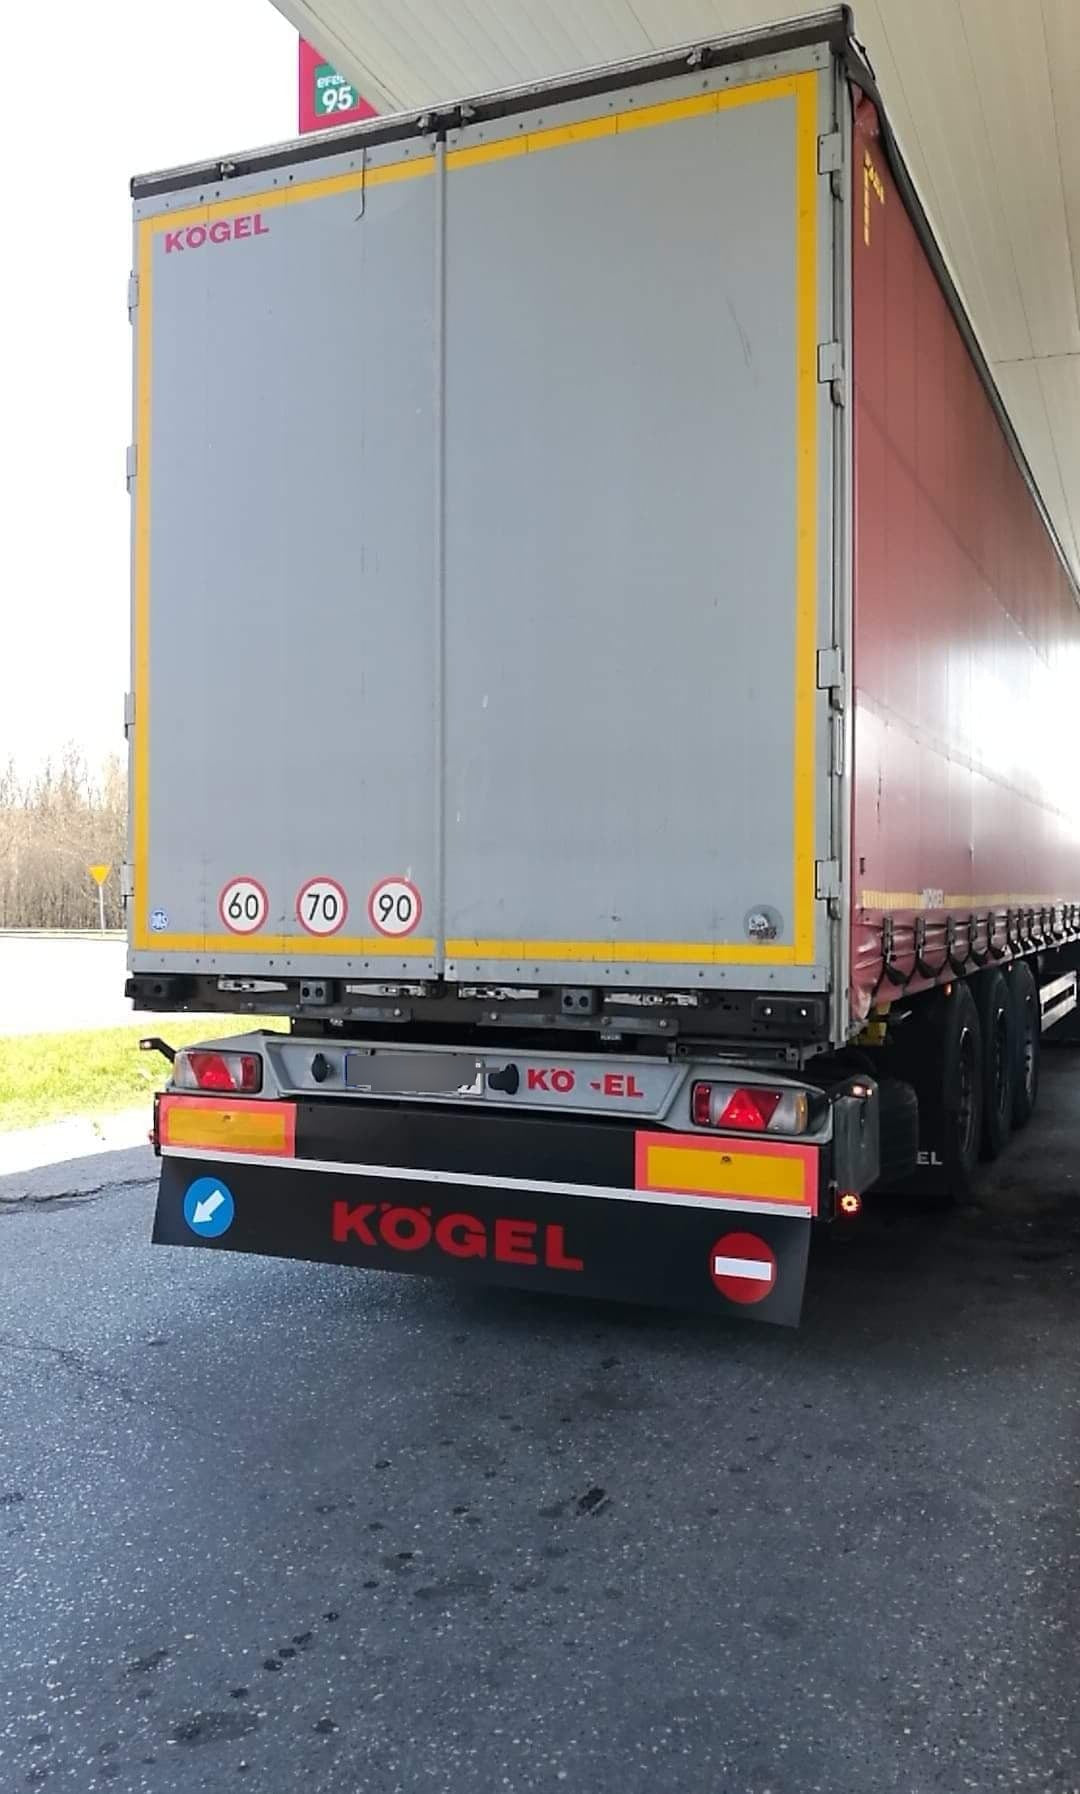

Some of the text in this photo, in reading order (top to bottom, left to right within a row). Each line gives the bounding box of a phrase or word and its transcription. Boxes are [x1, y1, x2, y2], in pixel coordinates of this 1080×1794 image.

[321, 86, 354, 113] 95
[165, 213, 270, 253] KÖGEL
[228, 892, 259, 920] 60
[307, 894, 338, 921] 70
[378, 894, 412, 922] 90
[527, 1067, 645, 1099] KÖEL
[331, 1200, 585, 1272] KÖGEL
